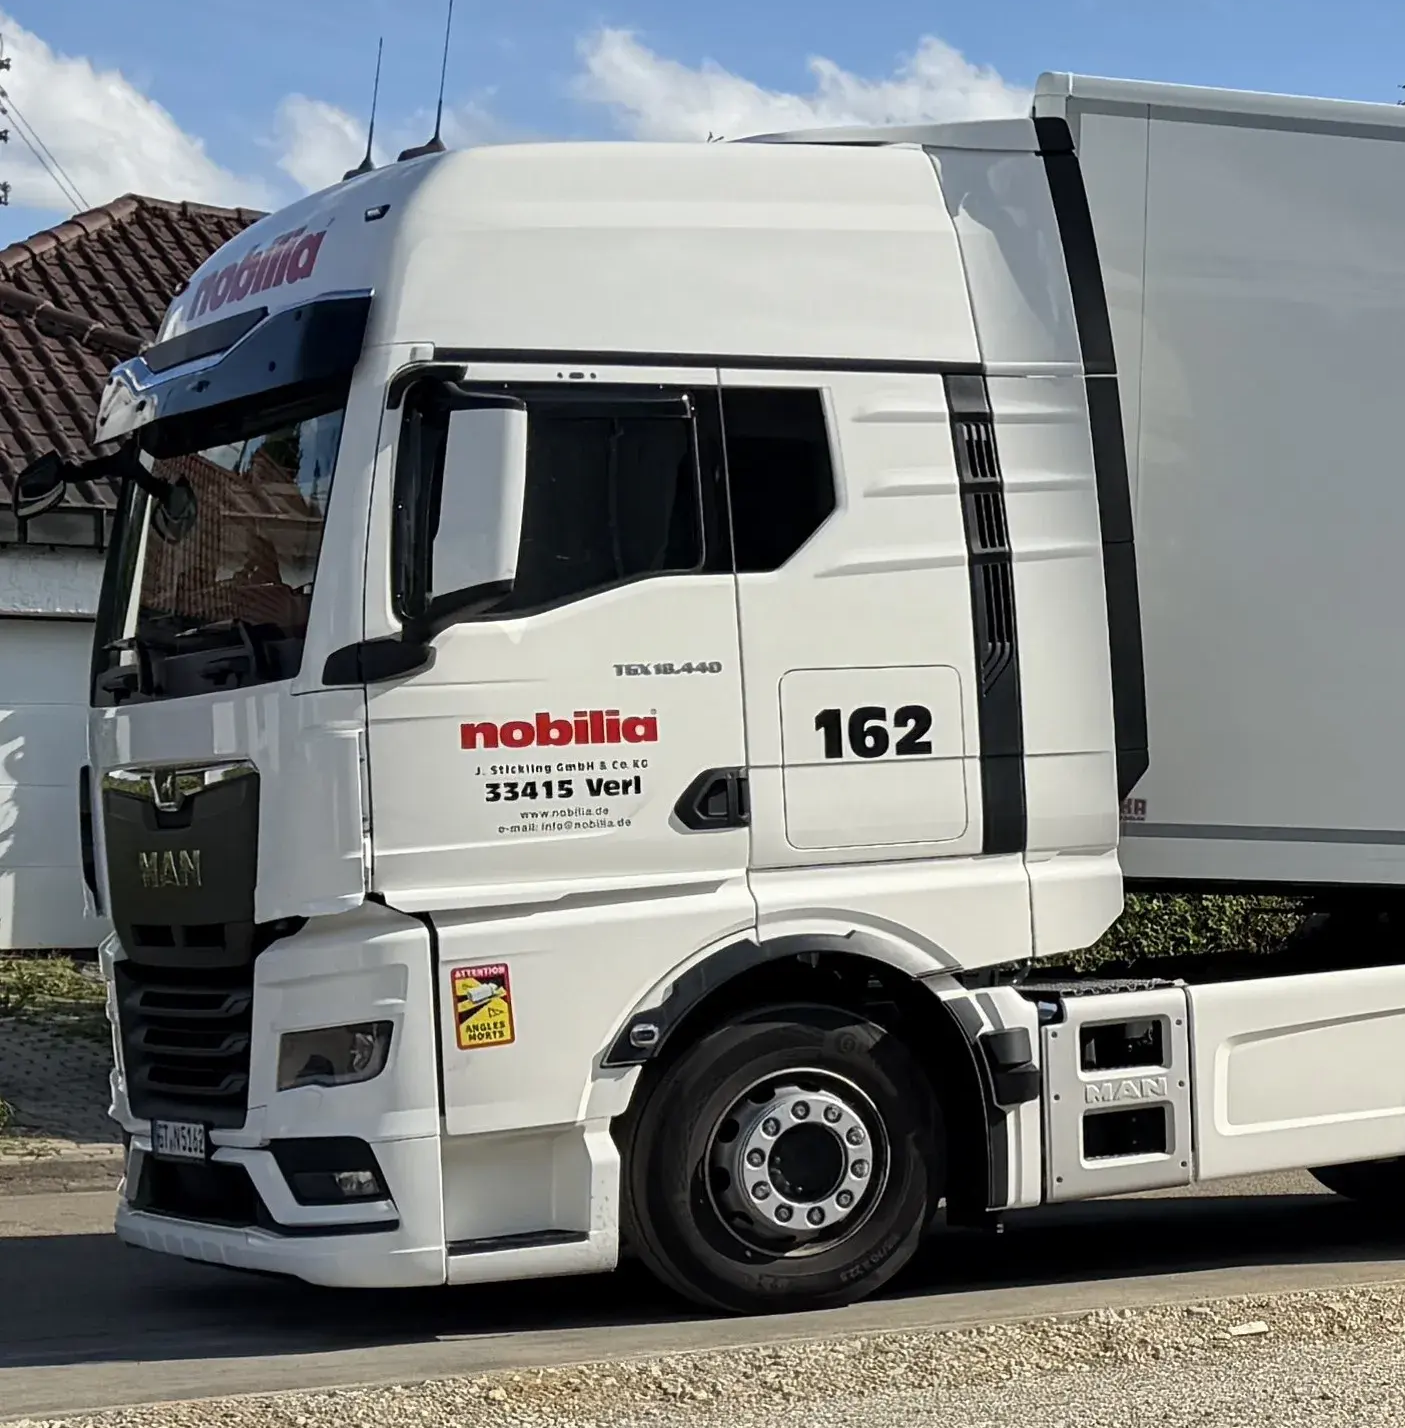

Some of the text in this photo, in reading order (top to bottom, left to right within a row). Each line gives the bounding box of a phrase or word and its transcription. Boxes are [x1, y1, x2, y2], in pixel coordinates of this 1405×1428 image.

[460, 709, 658, 749] nobilia
[815, 705, 932, 759] 162
[556, 761, 595, 773] GmbH
[599, 760, 607, 771] &
[632, 759, 649, 769] KG
[485, 775, 642, 803] 33415 Verl
[520, 806, 609, 820] www.nobilia.de
[498, 817, 632, 834] e-mail: info@nobilia.de
[140, 849, 202, 888] MAN
[454, 966, 506, 979] ATTENTION
[466, 1020, 506, 1033] ANGLES
[468, 1030, 505, 1042] MORTS
[1084, 1076, 1168, 1104] MAN
